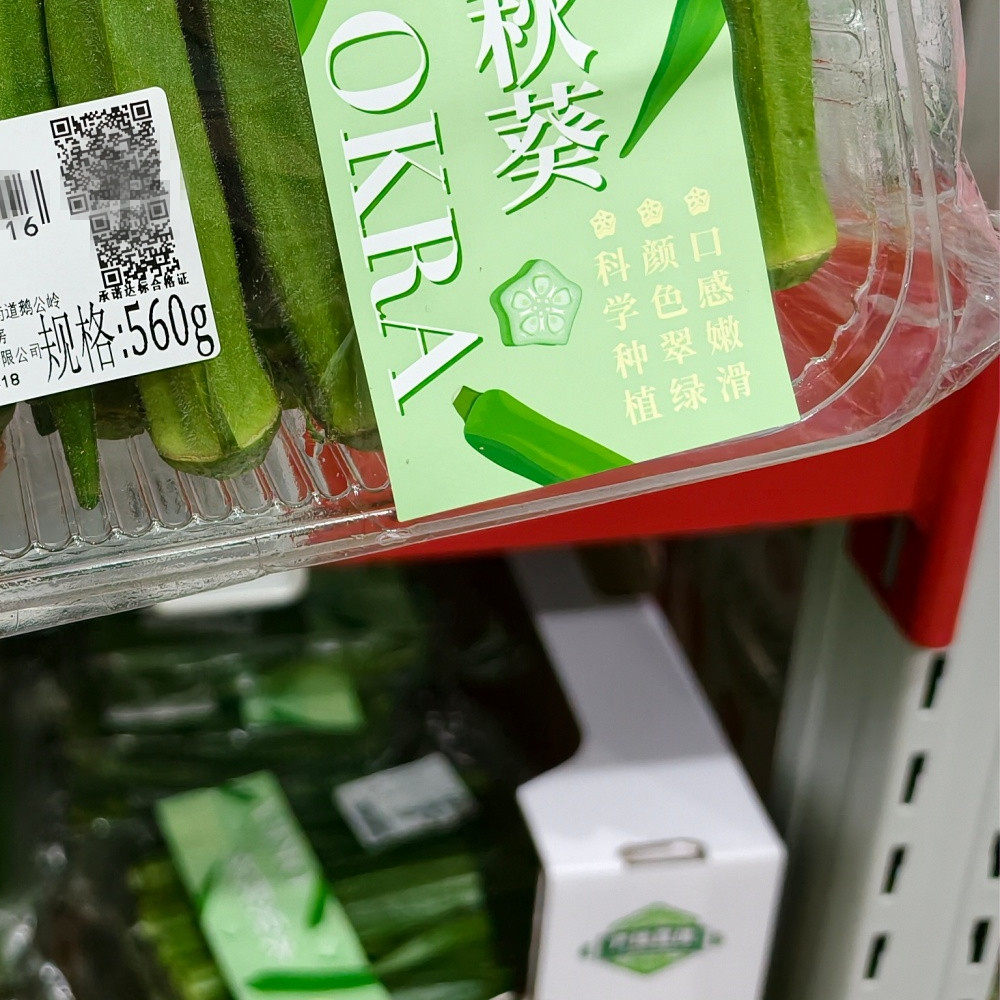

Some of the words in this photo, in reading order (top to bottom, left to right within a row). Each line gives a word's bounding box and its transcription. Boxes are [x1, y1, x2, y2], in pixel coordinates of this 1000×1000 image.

[99, 271, 190, 303] 承诺达标合格证
[325, 10, 483, 417] OKRA
[594, 247, 663, 426] 科学种植
[641, 235, 707, 412] 颜色翠绿
[690, 226, 751, 403] 口感嫩滑
